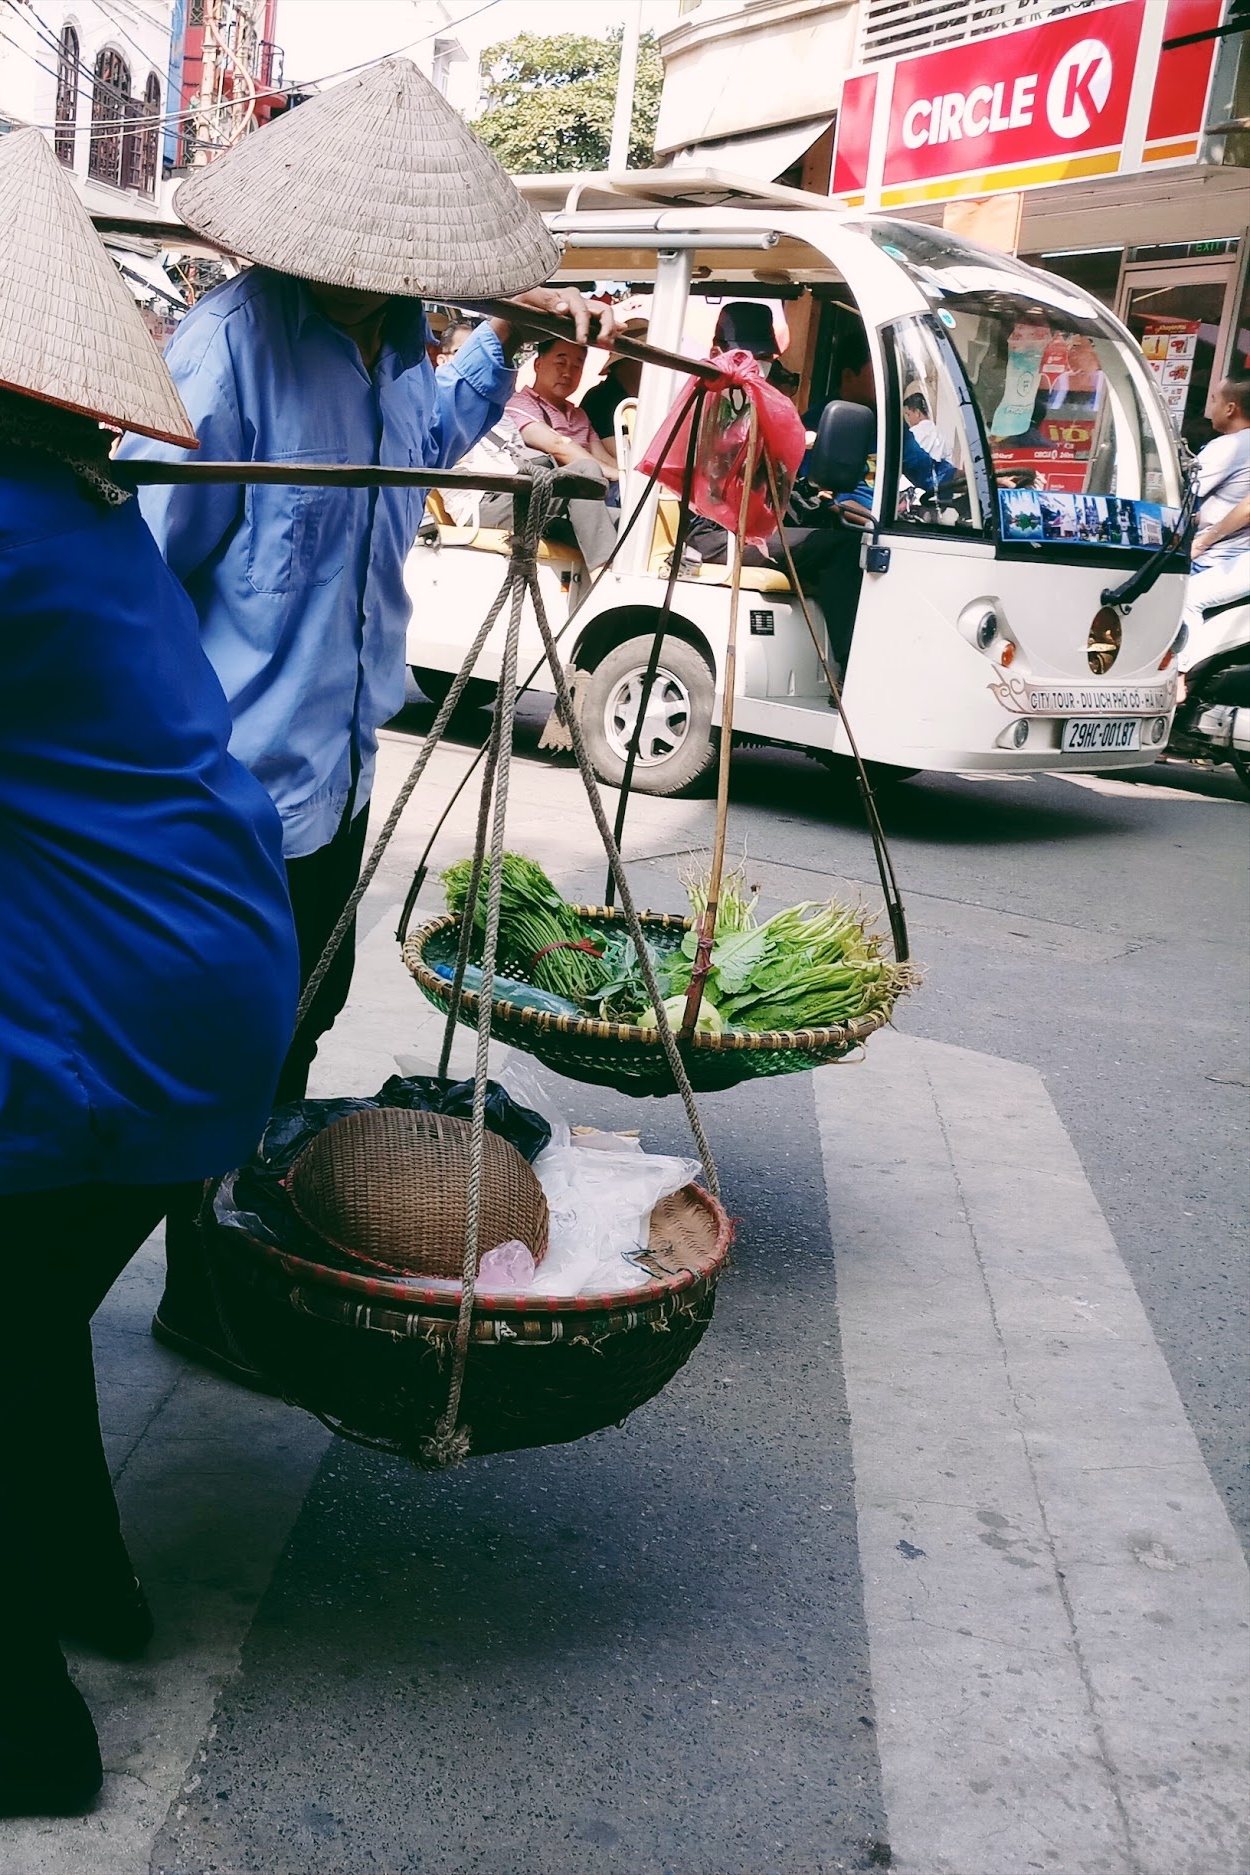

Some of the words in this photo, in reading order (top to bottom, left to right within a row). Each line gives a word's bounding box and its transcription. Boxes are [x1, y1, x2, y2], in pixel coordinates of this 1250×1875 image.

[902, 73, 1038, 149] CIRCLE
[1031, 692, 1050, 709] CITY
[1052, 692, 1075, 708] TOUR
[1081, 692, 1092, 708] DU
[1068, 722, 1136, 748] 29HC-001.87
